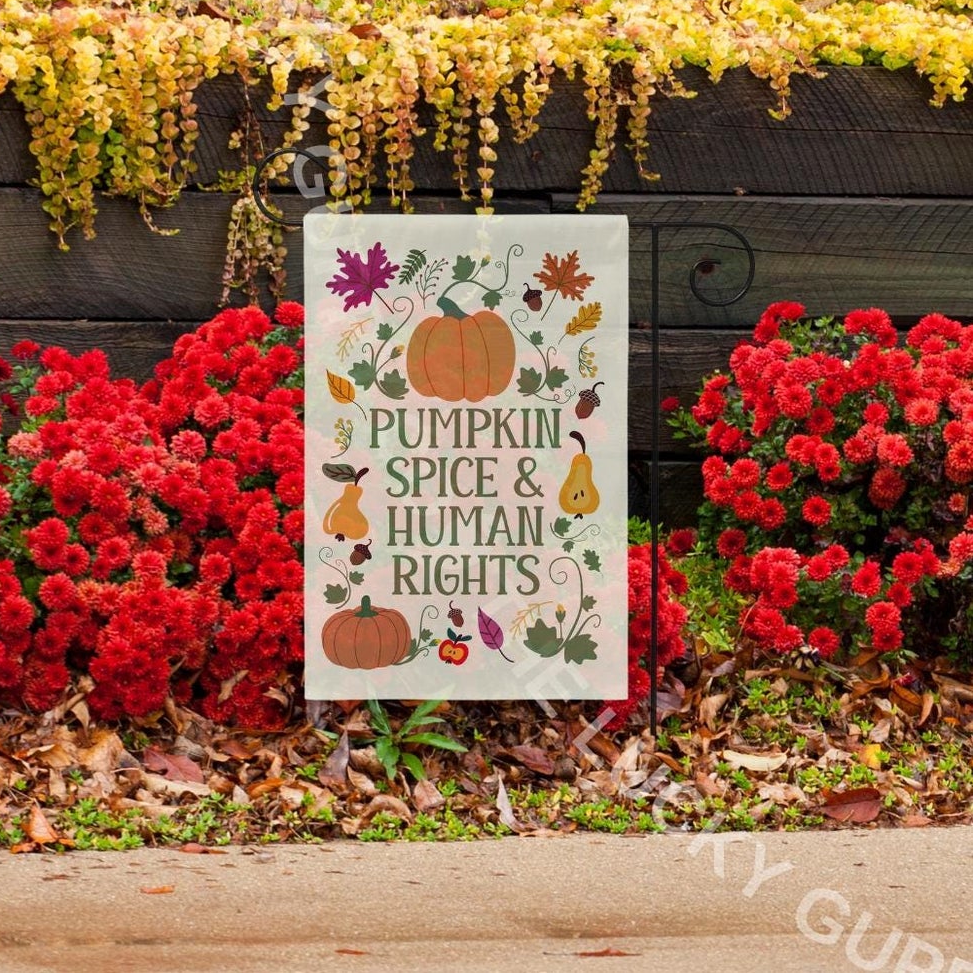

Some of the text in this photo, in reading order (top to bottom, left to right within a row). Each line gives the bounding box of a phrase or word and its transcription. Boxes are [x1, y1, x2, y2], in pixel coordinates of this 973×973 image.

[368, 407, 563, 449] PUMPKIN
[385, 456, 545, 498] SPICE &
[386, 505, 544, 547] HUMAN
[391, 554, 541, 596] RIGHTS
